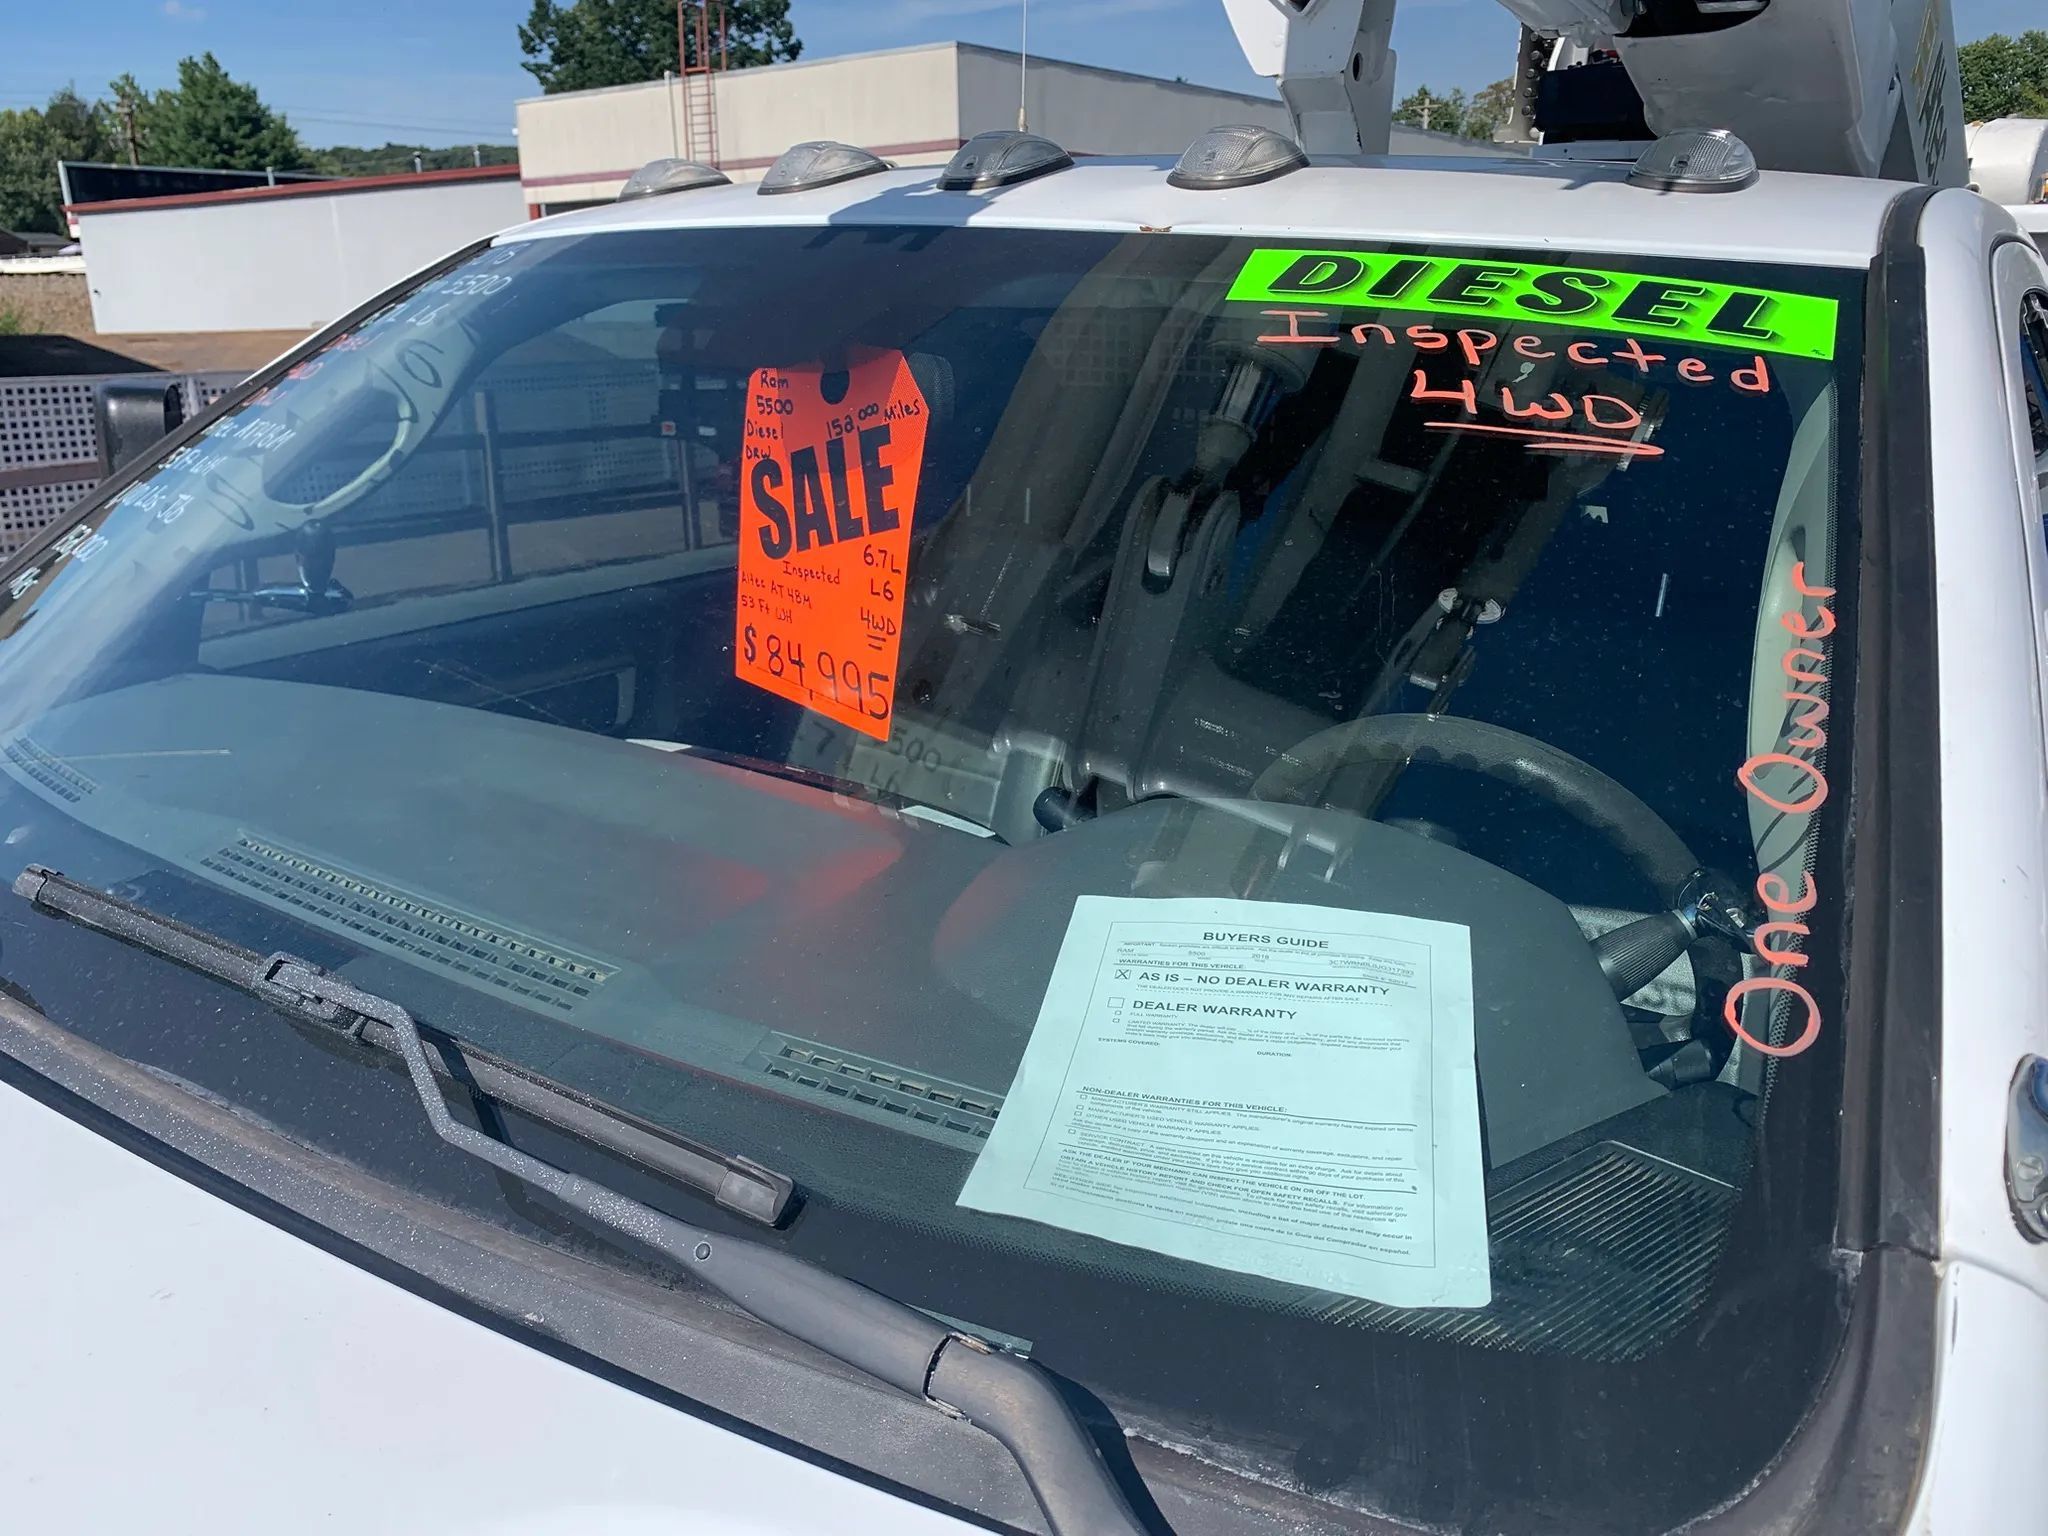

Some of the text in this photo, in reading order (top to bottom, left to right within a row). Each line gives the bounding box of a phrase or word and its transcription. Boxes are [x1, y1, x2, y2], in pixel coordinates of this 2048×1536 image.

[1267, 253, 1780, 344] DIESEL
[1257, 310, 1770, 395] Inspected
[760, 370, 789, 389] Ram
[756, 395, 794, 416] 5500
[1410, 369, 1643, 429] 4WD
[746, 419, 784, 440] Diesel
[751, 423, 900, 560] SALE
[863, 544, 901, 574] 6.7L
[782, 560, 840, 585] Inspected
[870, 578, 894, 601] L6
[860, 607, 897, 636] 4WD
[1724, 561, 1837, 1057] One Owner
[1203, 932, 1271, 944] BUYERS
[1277, 936, 1329, 949] GUIDE
[1139, 972, 1160, 981] AS
[1165, 973, 1179, 982] IS
[1198, 975, 1219, 985] NO
[1225, 977, 1290, 989] DEALER
[1295, 982, 1390, 996] WARRANTY
[1133, 1000, 1297, 1020] DEALER WARRANTY
[1082, 1086, 1139, 1098] NON-DEALER
[1141, 1093, 1200, 1105] WARRANTIES
[1246, 1104, 1288, 1112] VEHICLE:
[1095, 1153, 1122, 1163] DEALER
[1154, 1165, 1191, 1175] MECHANIC
[1209, 1174, 1240, 1183] INSPECT
[1258, 1182, 1288, 1190] VEHICLE
[1207, 1181, 1232, 1190] CHECK
[1273, 1192, 1302, 1200] SAFETY
